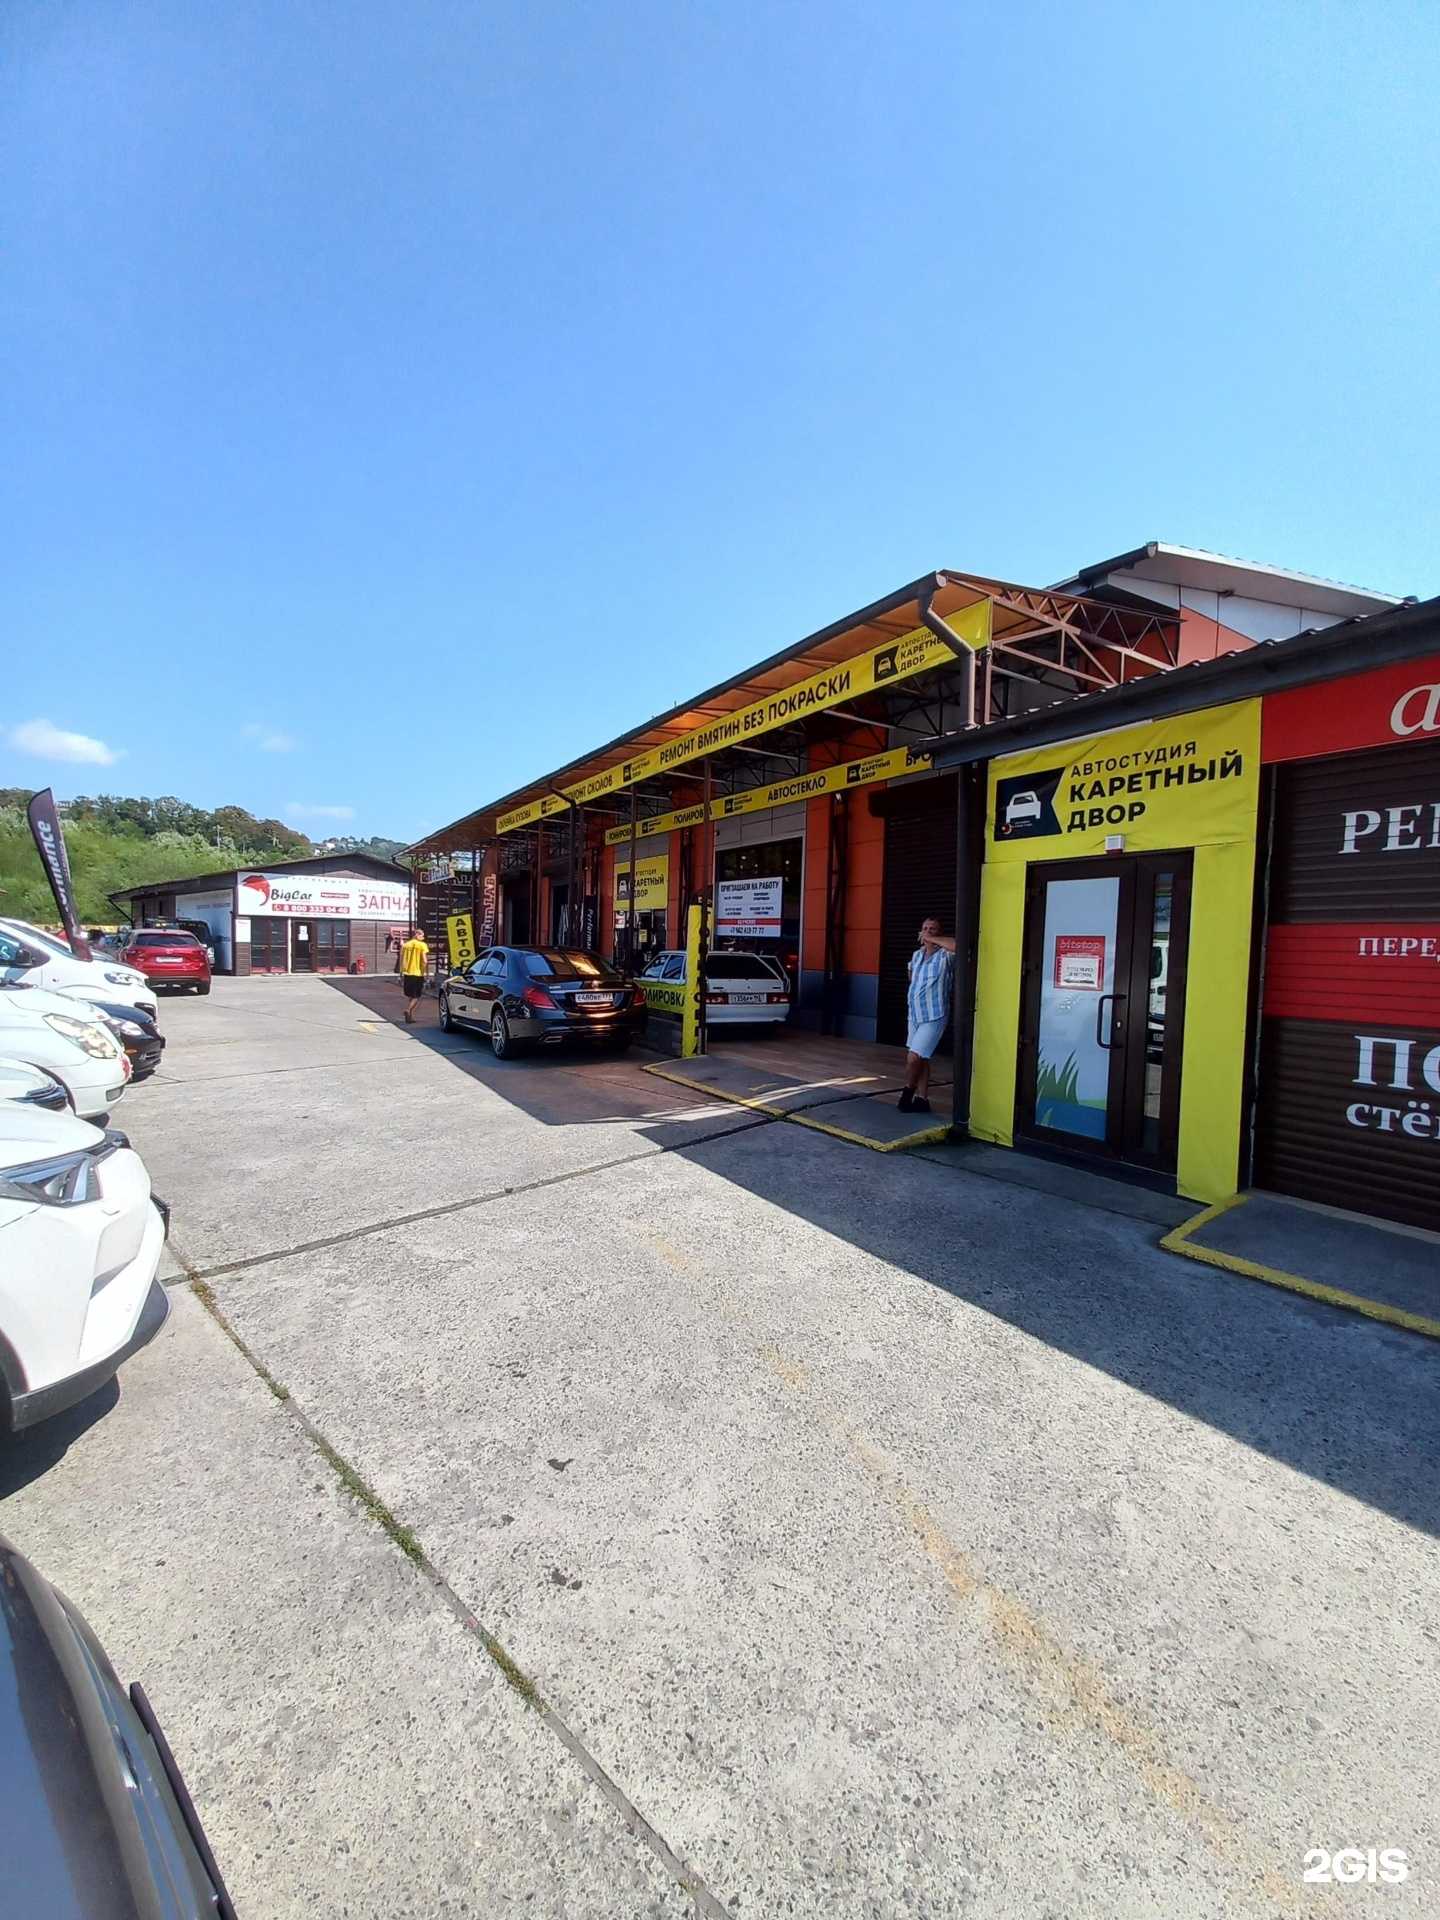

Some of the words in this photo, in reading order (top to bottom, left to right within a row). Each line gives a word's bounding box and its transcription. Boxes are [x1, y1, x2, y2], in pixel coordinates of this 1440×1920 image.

[900, 631, 936, 649] АВТОСТУД
[900, 638, 945, 660] КАРЕТН
[900, 654, 926, 673] ДВОР
[659, 736, 697, 765] РЕМОНТ
[697, 722, 741, 750] ВМЯТИН
[743, 706, 765, 734] БЕЗ
[767, 670, 851, 720] ПОКРАСКИ
[1070, 740, 1197, 779] АВТОСТУДИЯ
[587, 774, 613, 795] СКОЛОВ
[1068, 750, 1242, 802] КАРЕТНЫЙ
[768, 775, 826, 802] АВТОСТЕКЛО
[673, 804, 713, 825] ПОЛИРОВА
[1066, 801, 1146, 833] ДВОР
[270, 889, 313, 901] BigCar
[759, 881, 779, 889] РАБОТУ
[1358, 937, 1440, 963] ПЕРЕ
